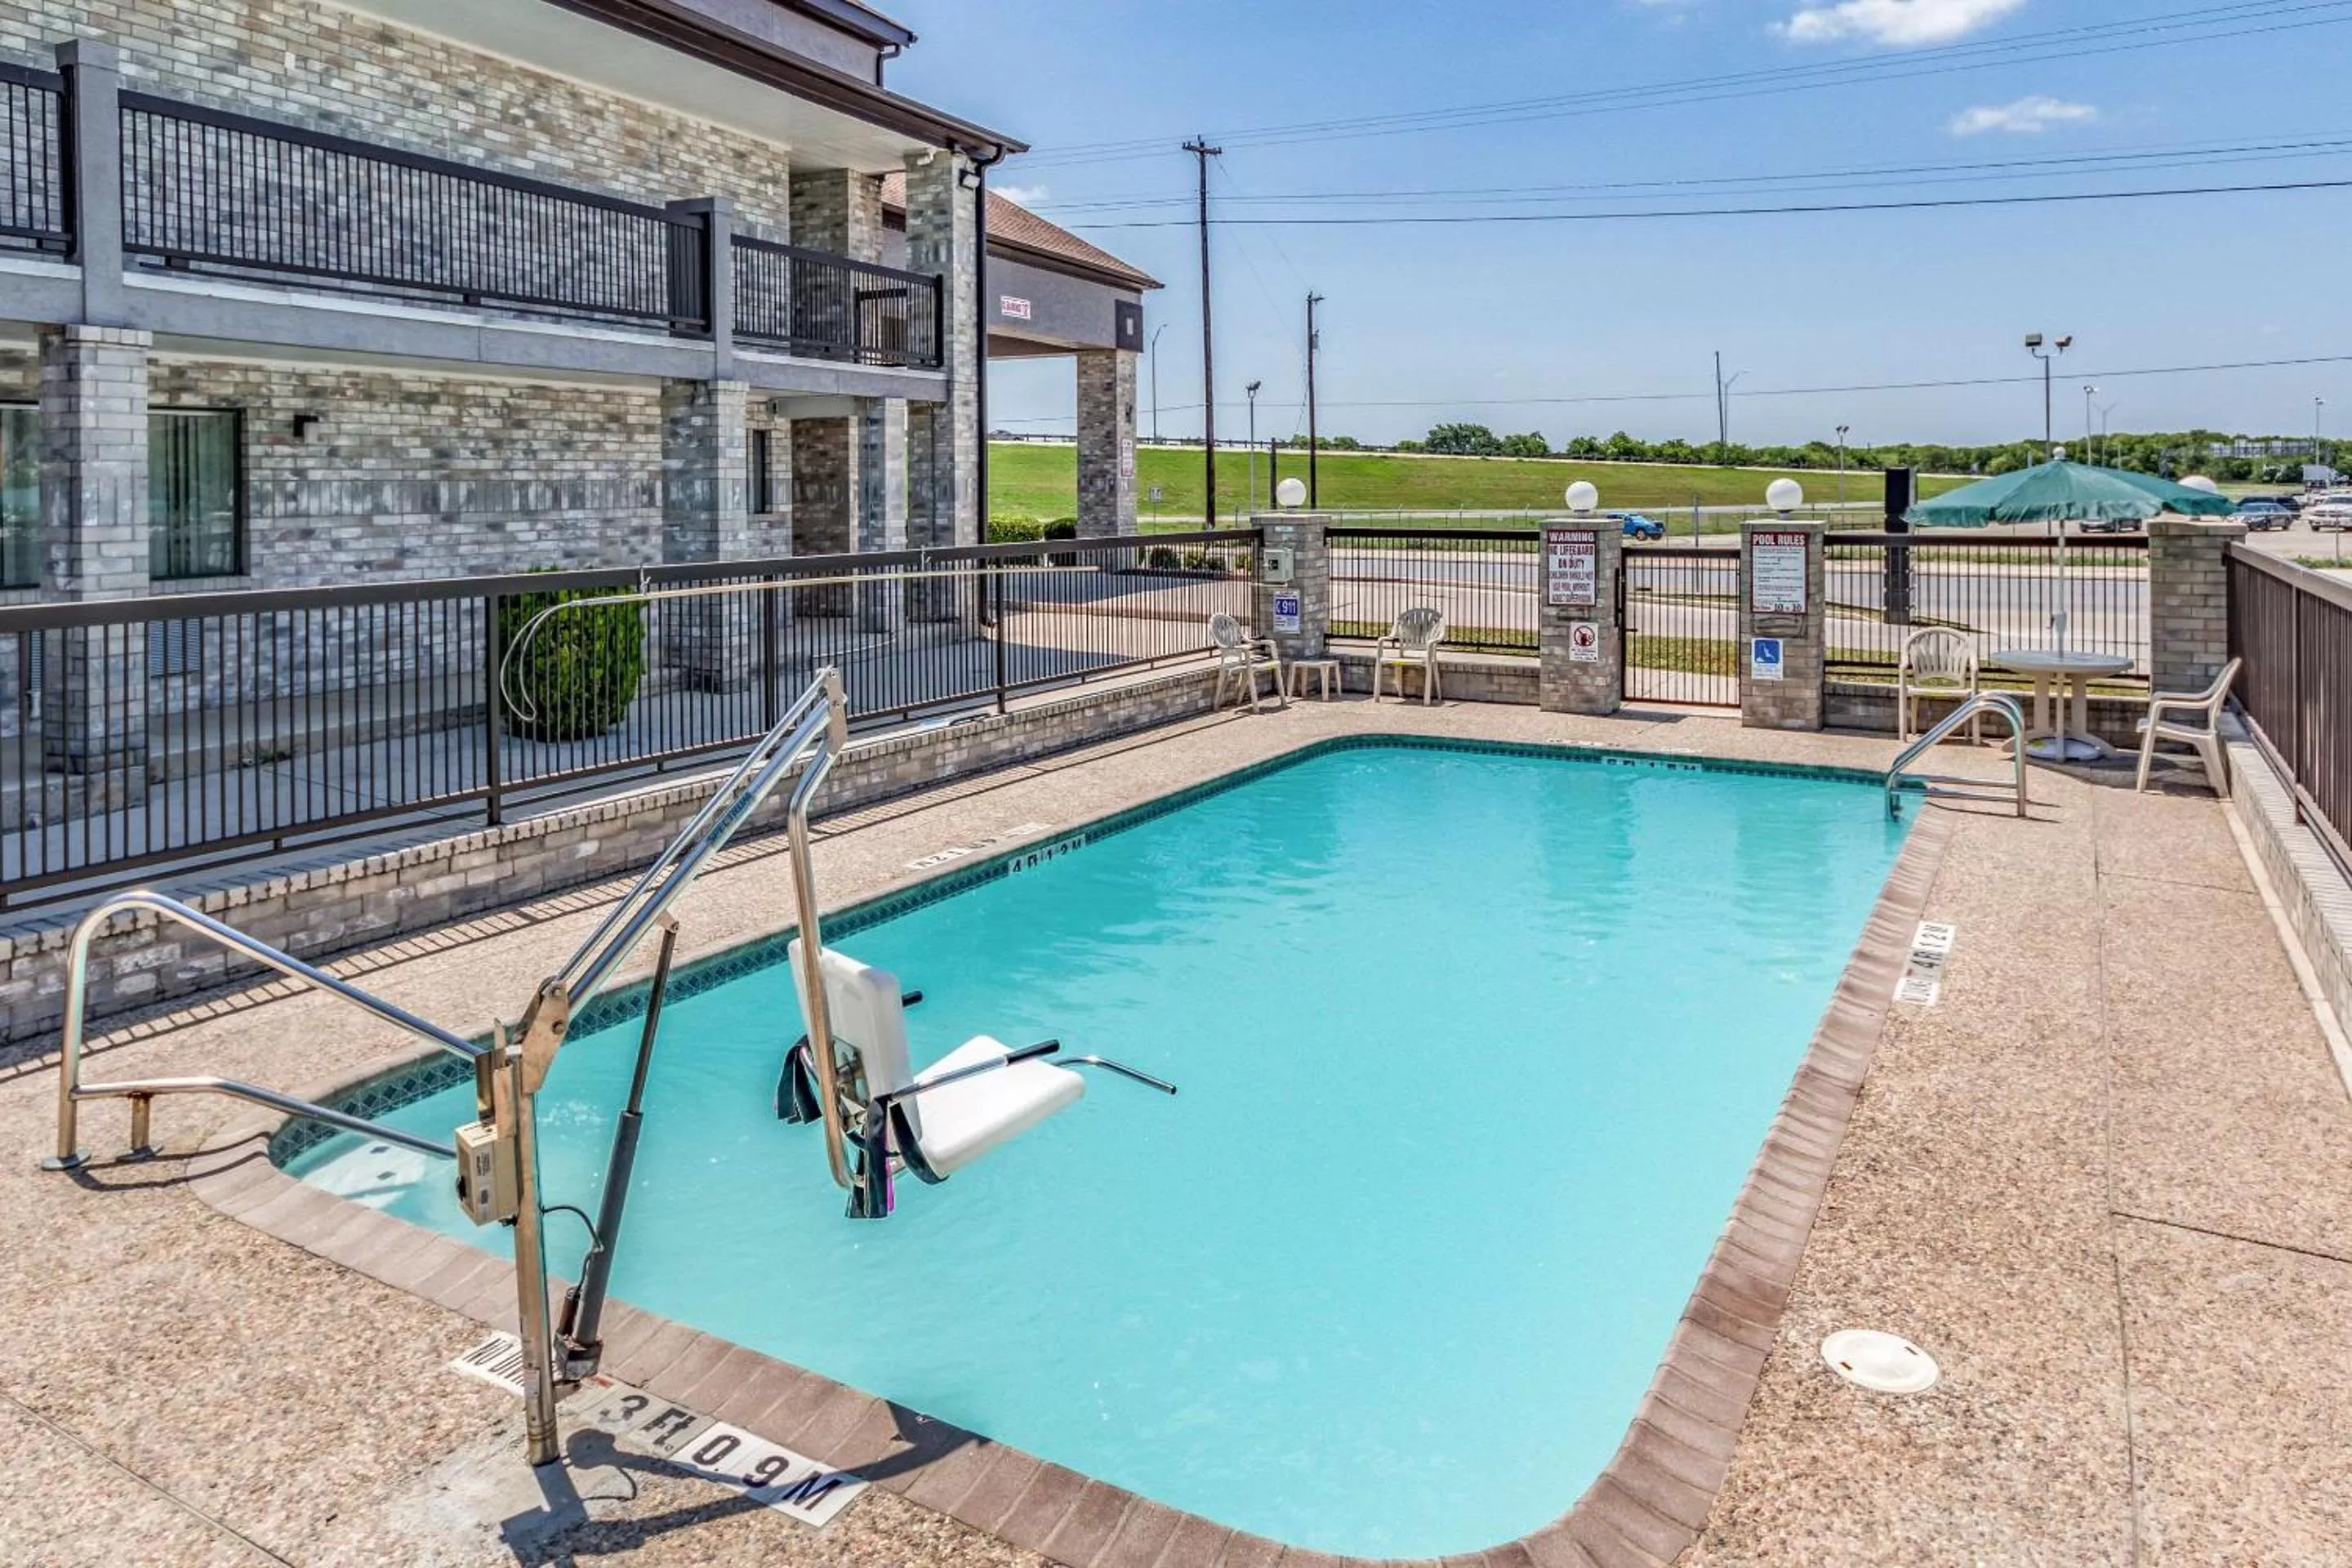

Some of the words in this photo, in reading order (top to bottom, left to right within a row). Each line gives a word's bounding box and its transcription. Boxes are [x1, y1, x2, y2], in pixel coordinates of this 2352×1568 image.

[1549, 532, 1594, 542] WARNING
[1753, 534, 1775, 545] POOL
[1778, 534, 1805, 546] RULES
[1560, 546, 1593, 555] LIFEGUARD
[1558, 559, 1566, 568] ON
[1569, 559, 1584, 568] DUTY
[1282, 600, 1296, 614] 911
[782, 1471, 843, 1512] M
